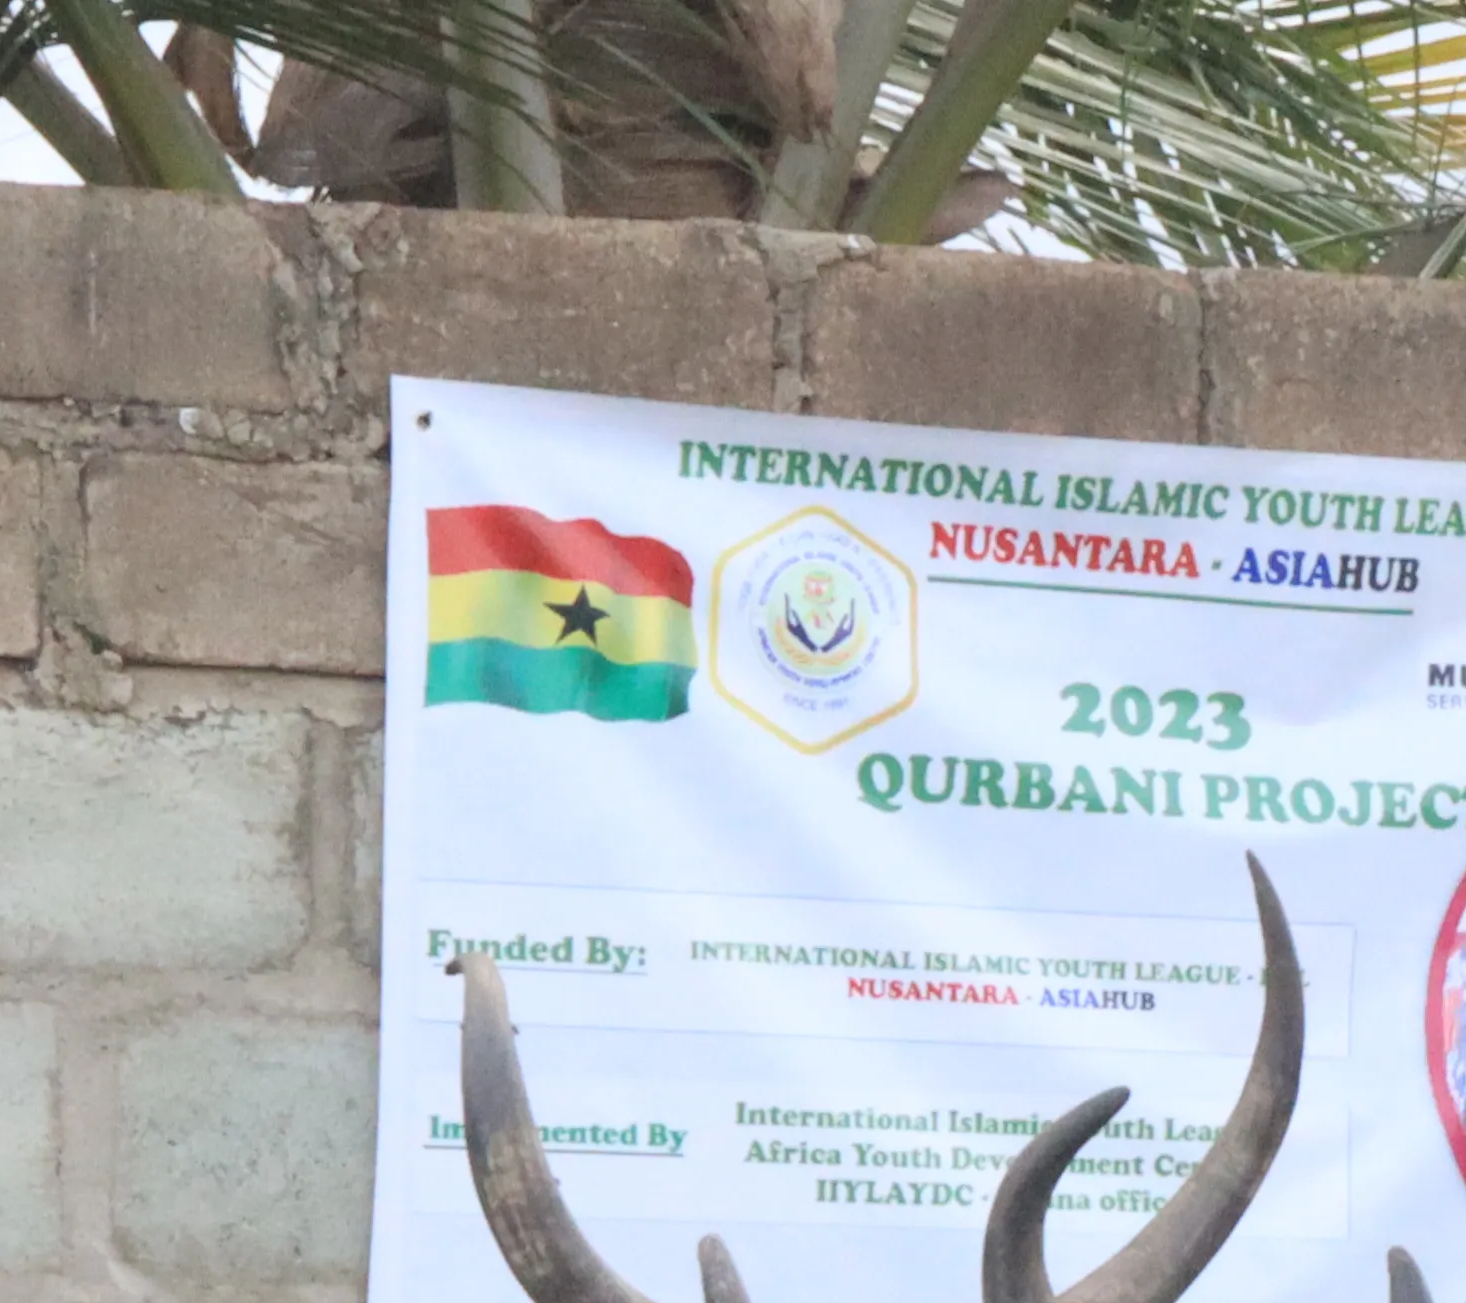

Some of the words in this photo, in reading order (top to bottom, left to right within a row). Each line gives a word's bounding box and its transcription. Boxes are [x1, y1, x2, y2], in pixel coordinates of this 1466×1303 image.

[677, 440, 1044, 507] INTERNATIONAL
[1054, 474, 1229, 519] ISLAMIC
[1241, 485, 1383, 530] YOUTH
[929, 521, 1200, 579] NUSANTARA
[1232, 547, 1421, 593] ASIAHUB
[1058, 682, 1253, 751] 2023
[855, 752, 1184, 816] QURBANI
[586, 936, 648, 974] By:
[690, 940, 916, 971] INTERNATIONAL
[923, 952, 1032, 976] ISLAMIC
[1036, 957, 1127, 981] YOUTH
[1135, 962, 1243, 986] LEAGUE
[846, 977, 1020, 1007] NUSANTARA
[1038, 988, 1156, 1012] ASIAHUB
[428, 1115, 638, 1147] Imented
[647, 1123, 688, 1153] By
[734, 1102, 939, 1133] International
[744, 1140, 842, 1166] Africa
[852, 1143, 943, 1170] Youth
[816, 1179, 974, 1208] IIYLAYDC
